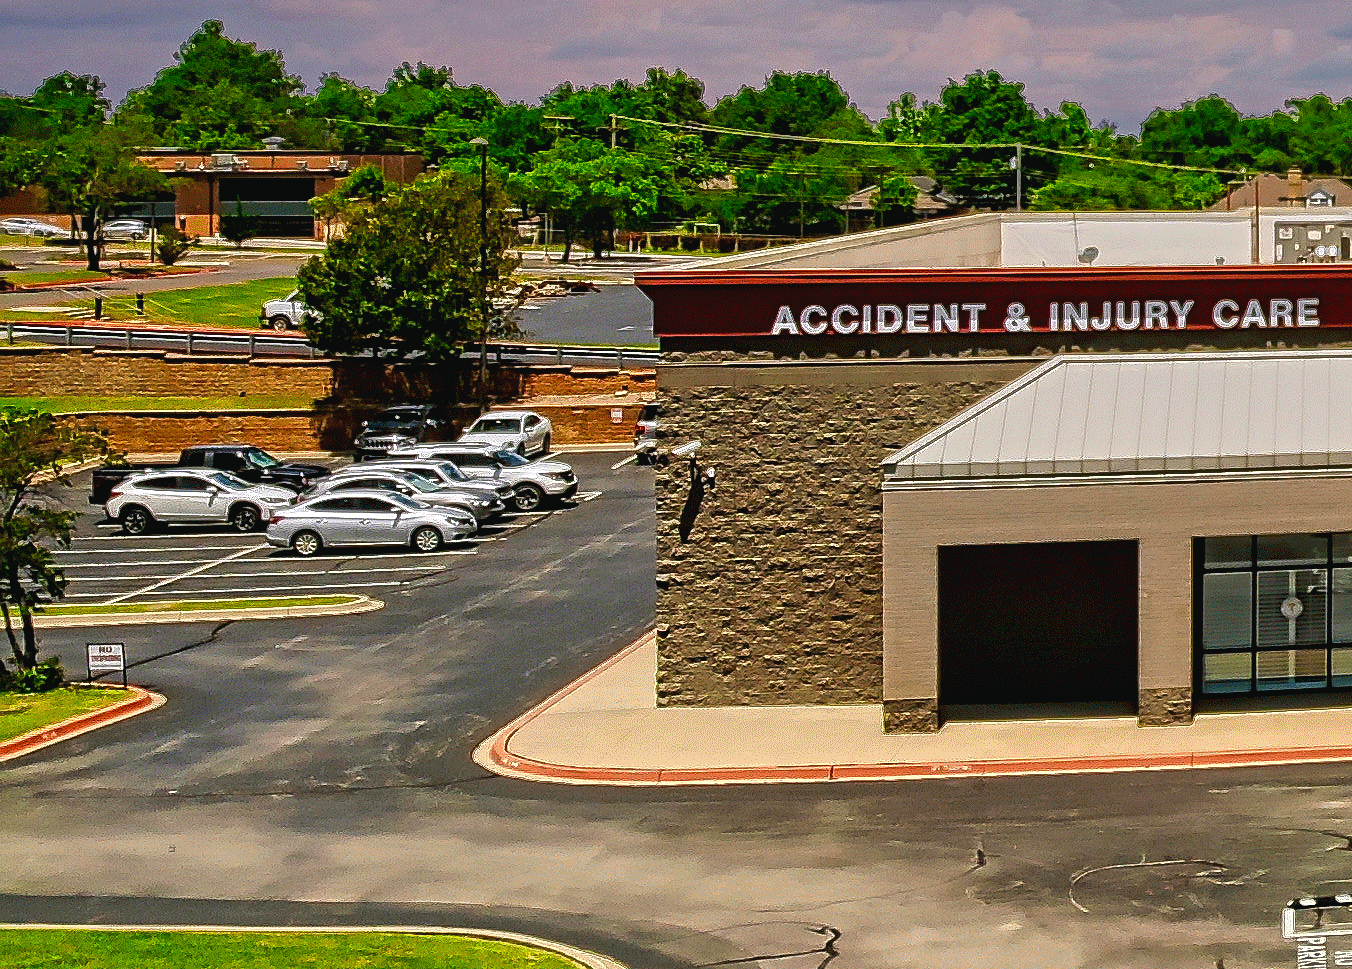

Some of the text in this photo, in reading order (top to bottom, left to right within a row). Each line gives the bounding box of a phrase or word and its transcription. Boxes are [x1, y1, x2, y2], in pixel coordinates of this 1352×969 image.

[771, 297, 1321, 335] ACCIDENT & INJURY CARE
[1296, 936, 1327, 969] PARKI
